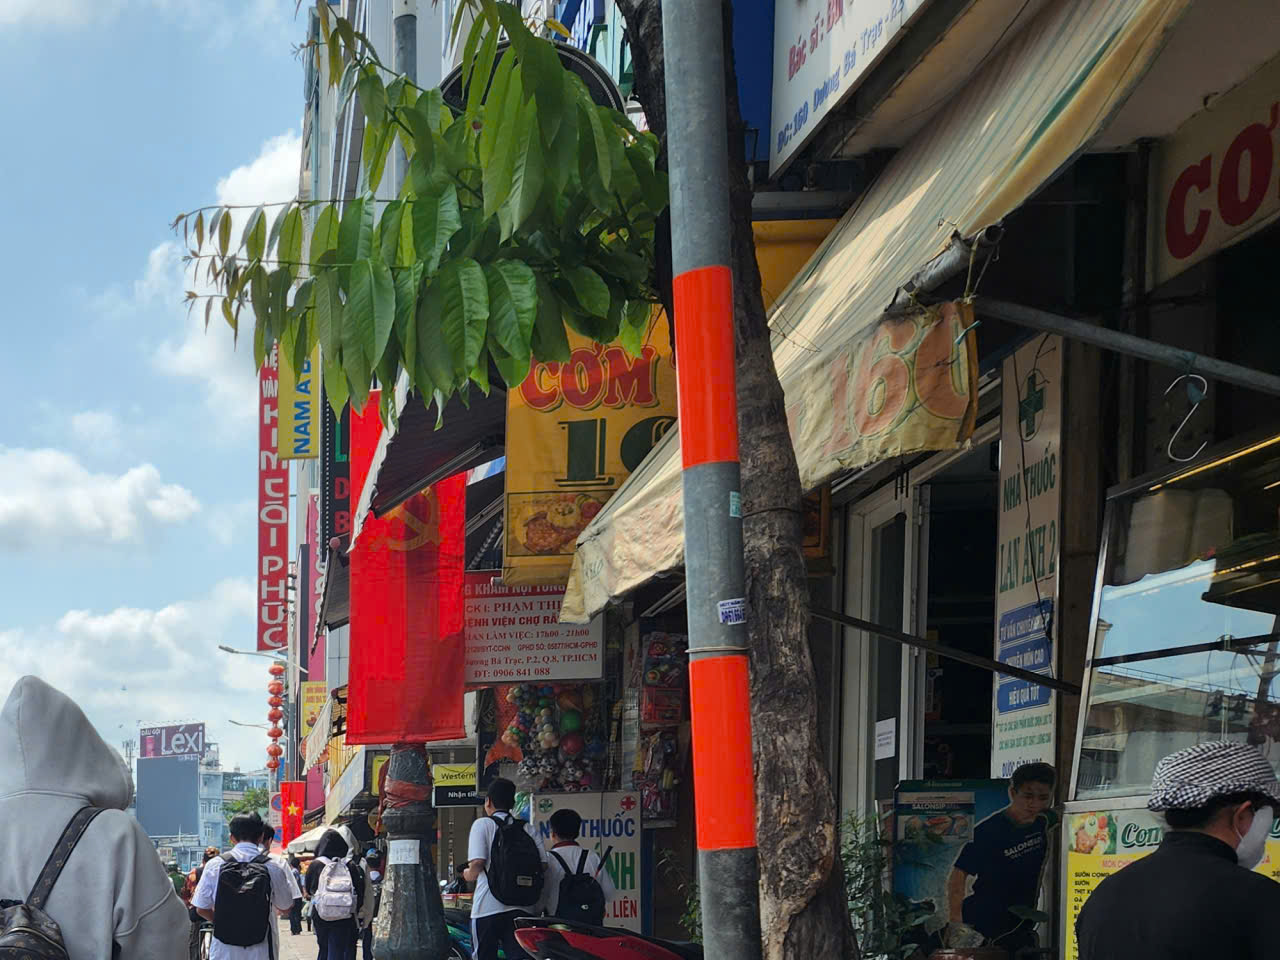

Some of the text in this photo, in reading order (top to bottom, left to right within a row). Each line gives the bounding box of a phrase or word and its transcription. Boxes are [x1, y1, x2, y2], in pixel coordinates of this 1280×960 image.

[1166, 101, 1280, 260] CƠ
[520, 341, 658, 412] CƠM
[293, 401, 311, 454] NAM
[1003, 441, 1056, 512] NHÀ THUỐC
[999, 536, 1021, 592] LAN
[1049, 519, 1056, 574] 2
[494, 602, 533, 613] PHẠM
[492, 615, 516, 627] VIỆN
[519, 615, 541, 626] CHỢ
[508, 630, 534, 641] VIỆC:
[536, 630, 559, 639] 17h00
[566, 628, 590, 638] 21h00
[474, 667, 550, 678] ĐT: 0906 841 088
[161, 725, 203, 755] Léxi
[448, 790, 467, 799] Nhận
[613, 896, 638, 918] LIÊN
